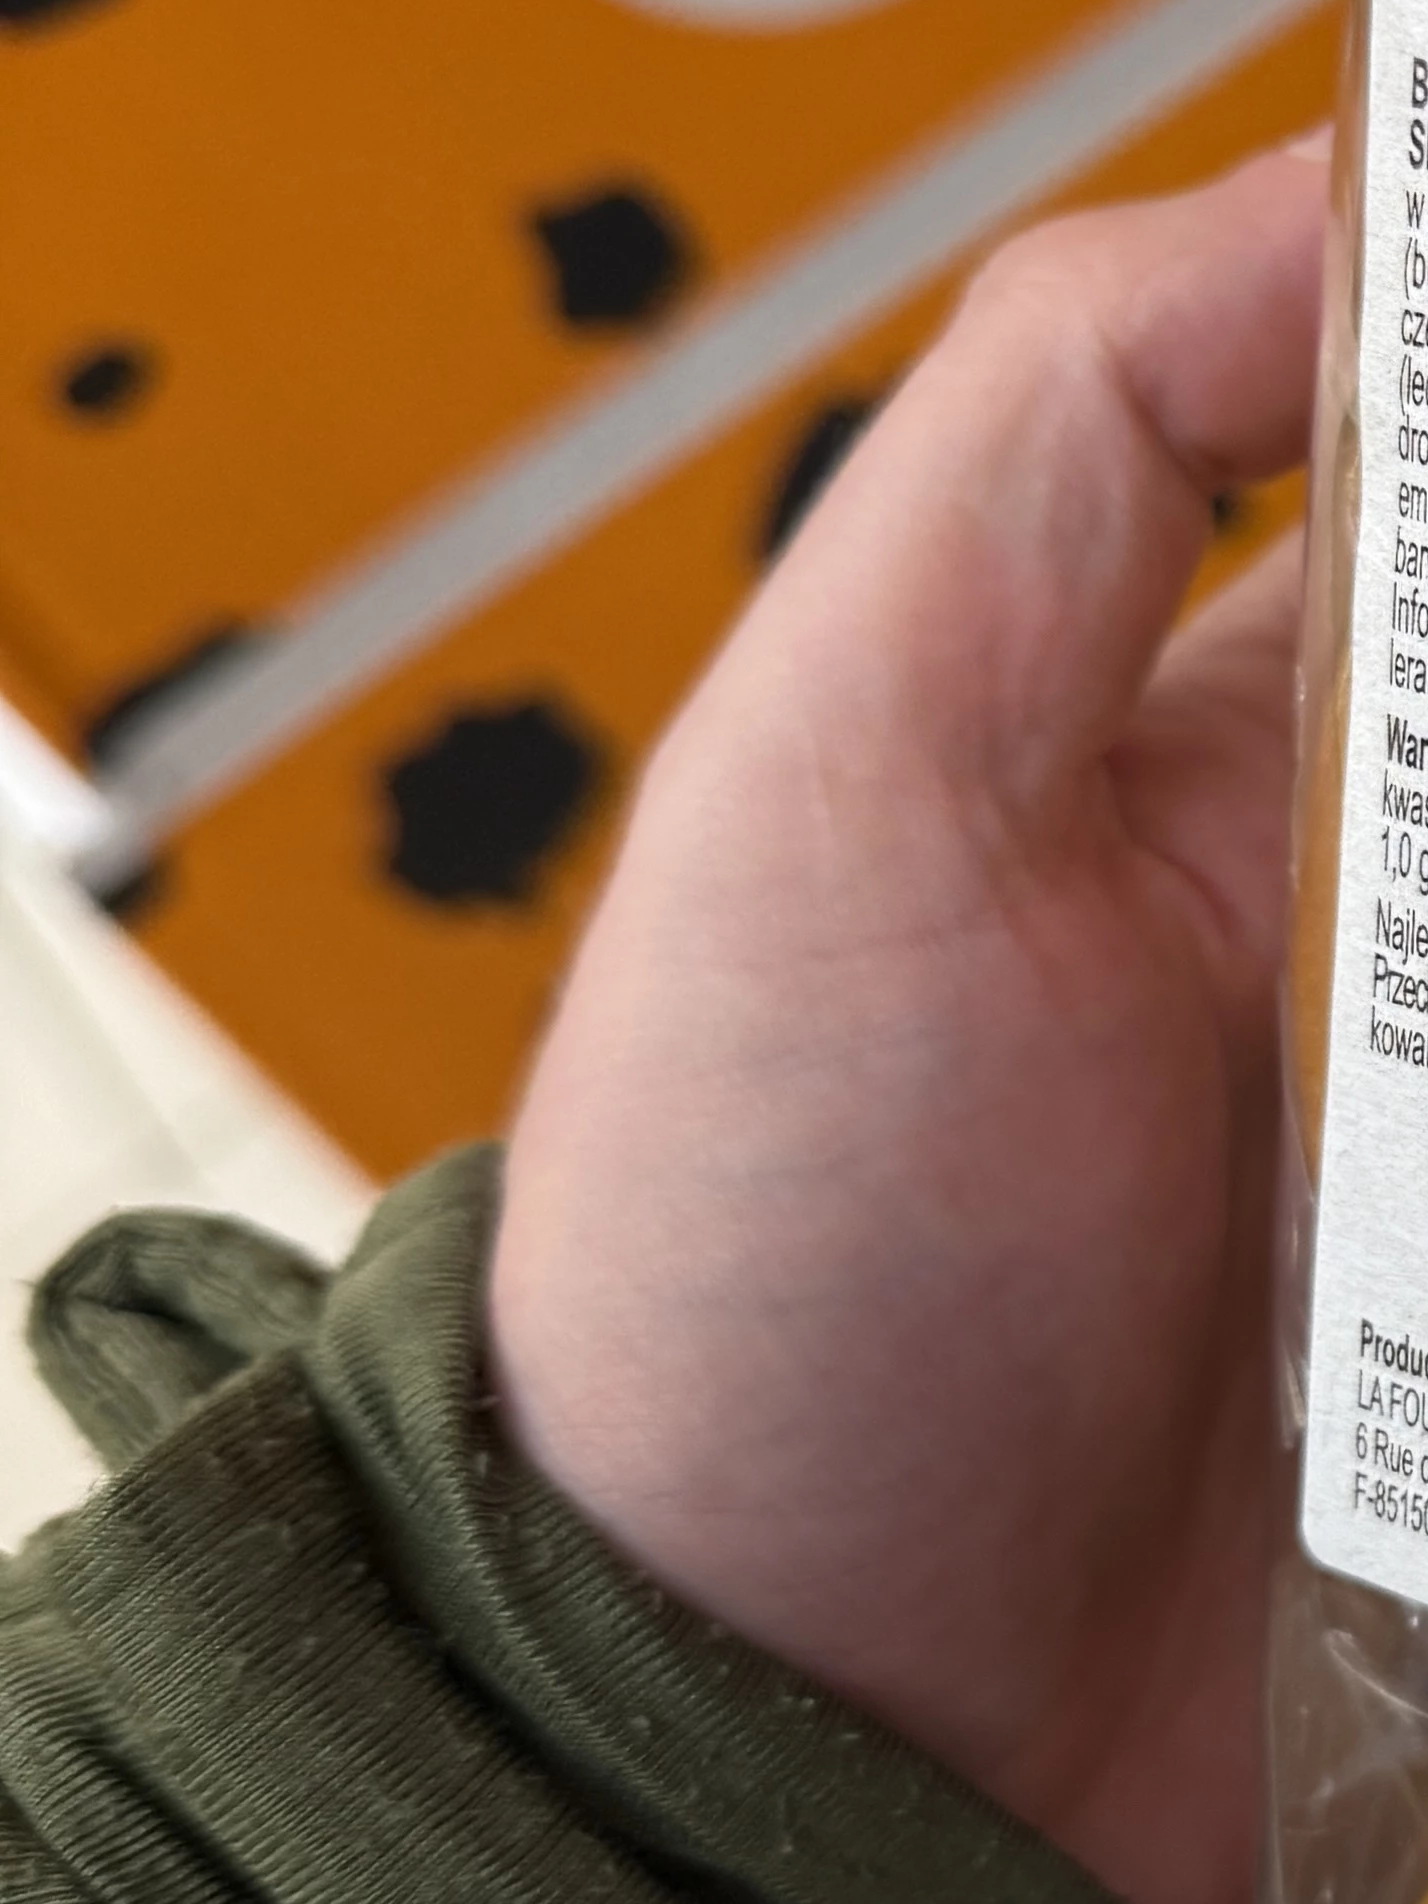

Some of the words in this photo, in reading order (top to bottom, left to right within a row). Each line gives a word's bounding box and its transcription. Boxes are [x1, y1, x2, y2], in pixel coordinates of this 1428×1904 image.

[1406, 189, 1425, 227] w
[1381, 827, 1411, 880] 1,0
[1356, 1369, 1387, 1417] LA
[1356, 1422, 1368, 1460] 6
[1374, 1426, 1414, 1478] Rue
